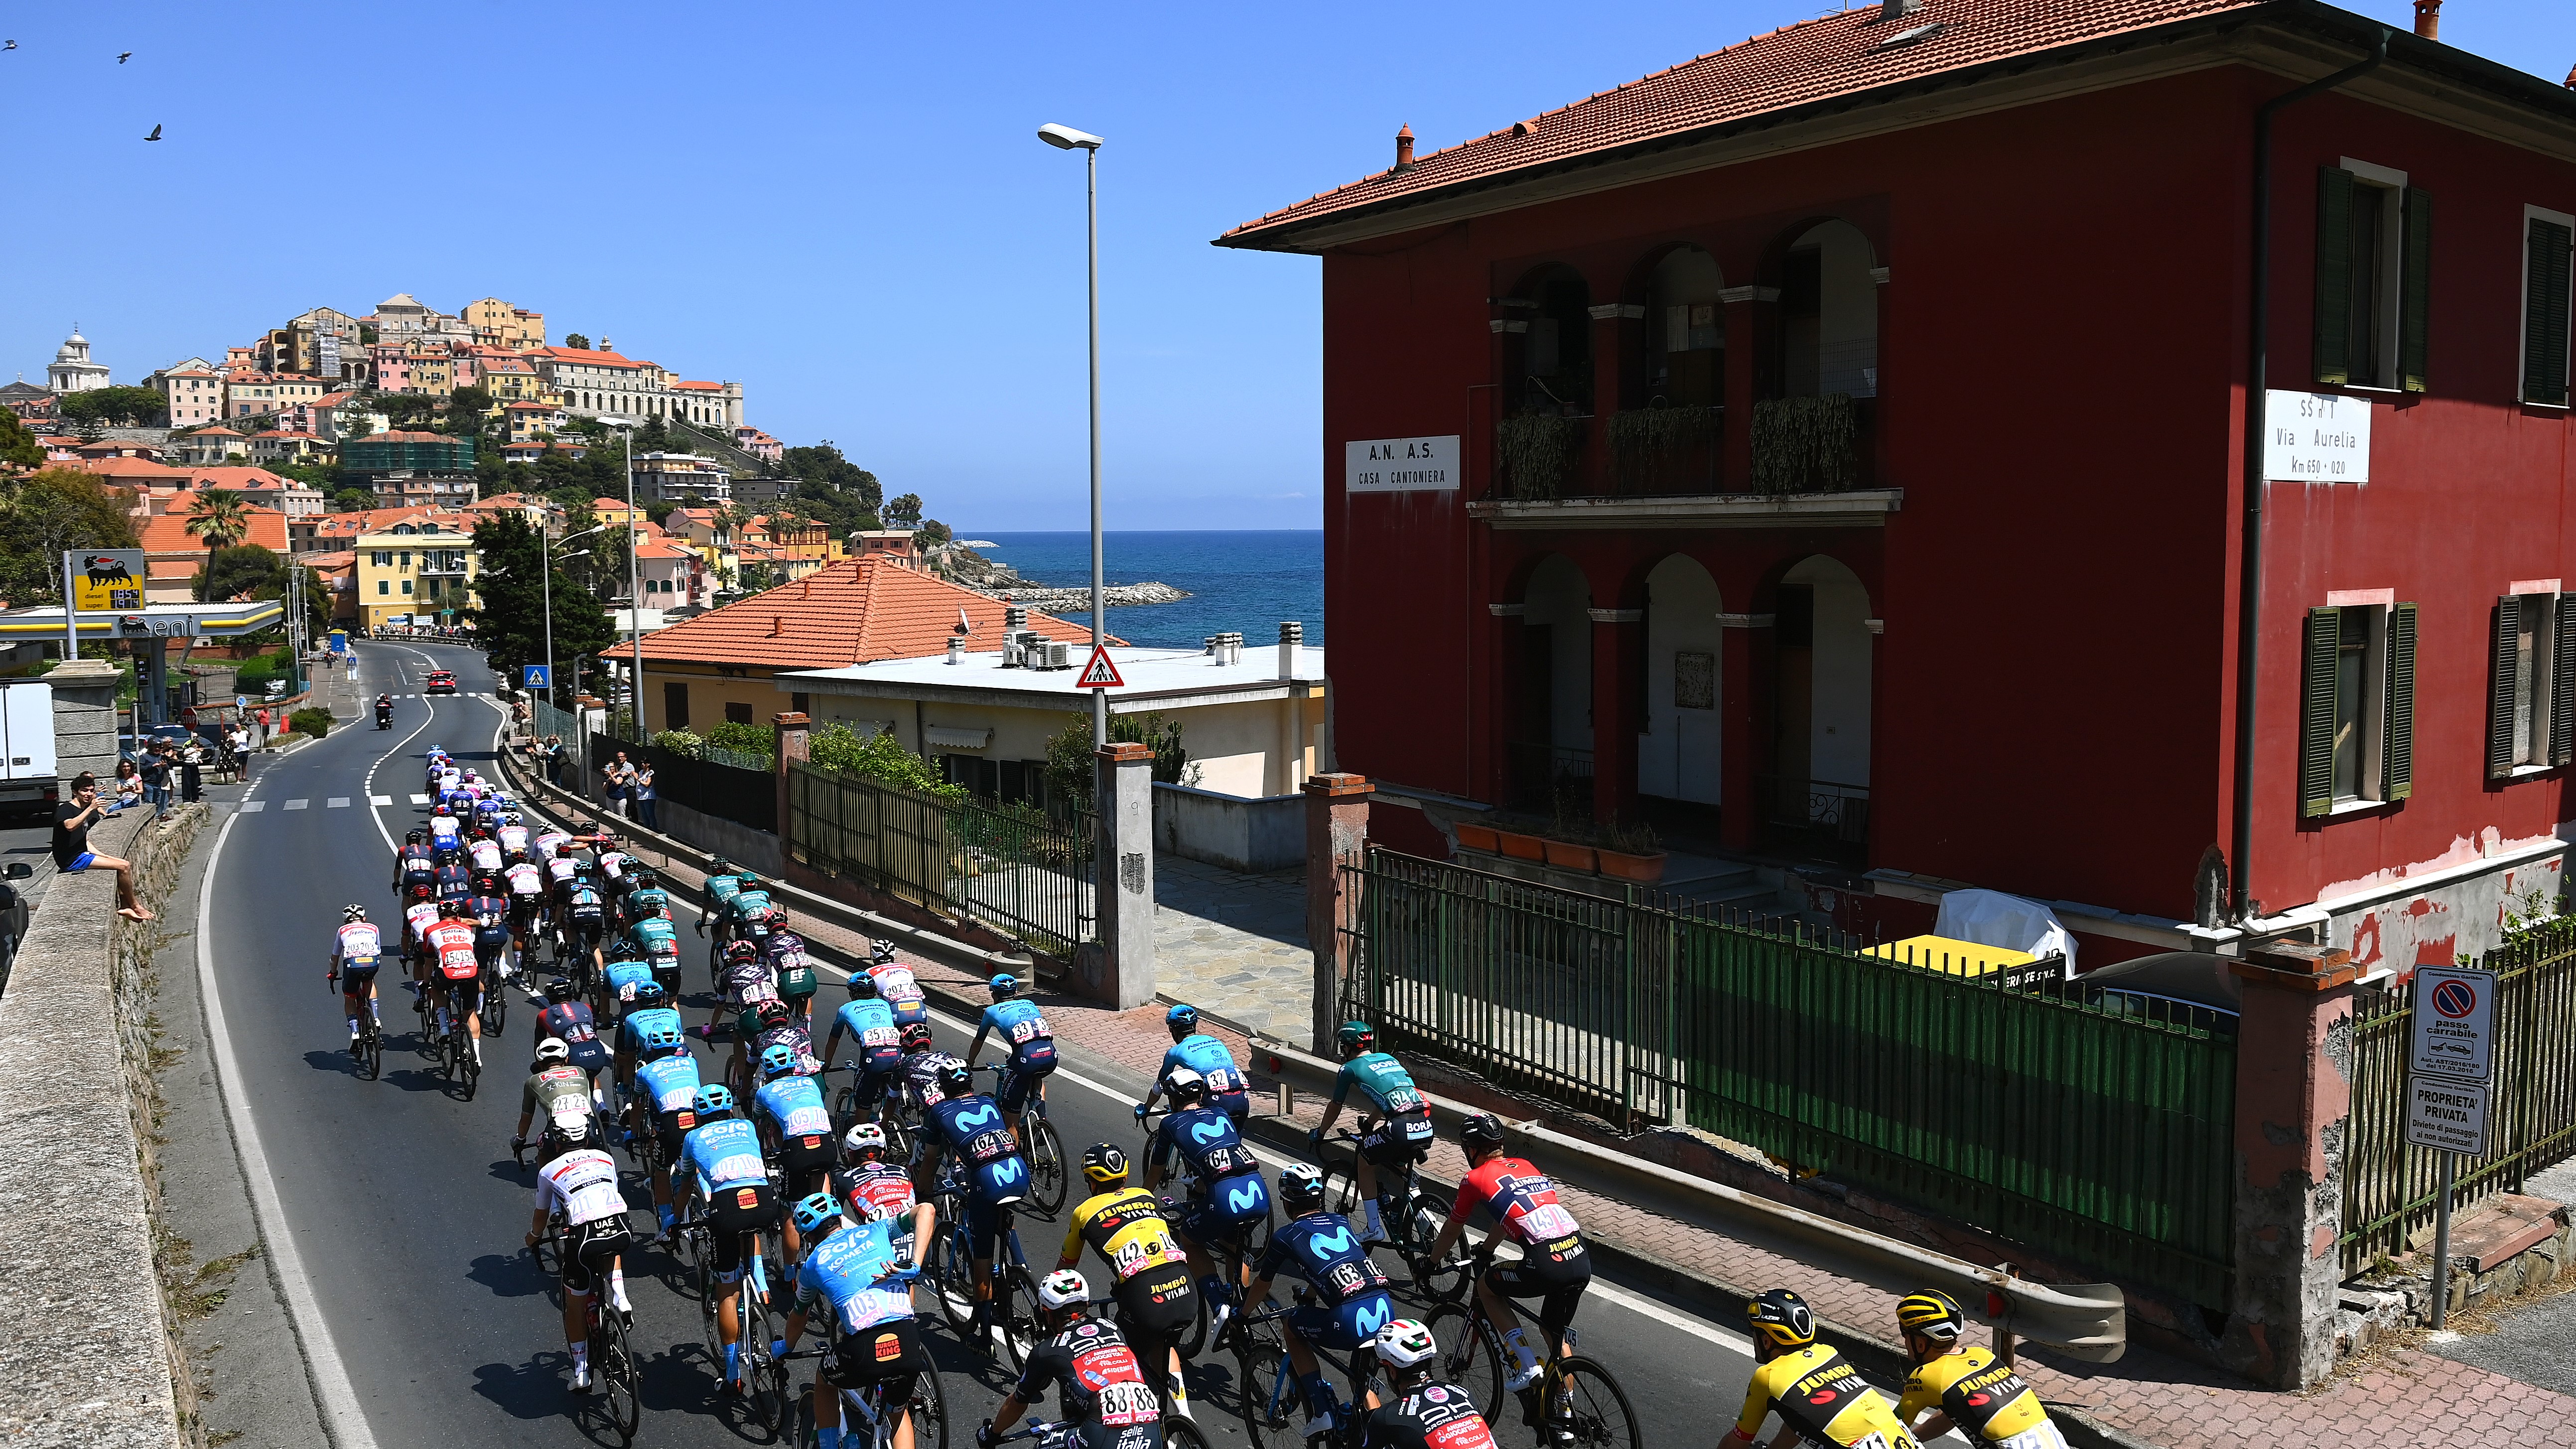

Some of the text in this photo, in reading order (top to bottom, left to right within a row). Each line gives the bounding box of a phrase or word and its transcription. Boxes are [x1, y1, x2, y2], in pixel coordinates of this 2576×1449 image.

[2277, 428, 2355, 448] Via Aurelia
[2307, 459, 2320, 474] 650
[2331, 460, 2345, 474] 020
[1358, 470, 1445, 485] CASA CANTONIERA
[153, 614, 193, 636] eni
[182, 714, 196, 723] STOP
[346, 943, 359, 953] 203
[650, 941, 660, 951] 66
[445, 952, 459, 964] 154
[782, 954, 793, 964] 95
[790, 968, 806, 981] EF
[622, 985, 632, 997] 31
[745, 988, 755, 998] 91
[765, 983, 776, 993] 91
[887, 984, 904, 996] 202
[1014, 1023, 1029, 1037] 33
[2436, 1020, 2469, 1029] passo
[867, 1028, 880, 1042] 35
[886, 1028, 899, 1040] 35
[1016, 1034, 1034, 1044] enel
[2426, 1028, 2478, 1039] carrabile
[1188, 1039, 1220, 1050] ASTANA
[652, 1059, 690, 1072] eolo
[2435, 1059, 2480, 1069] AST/2016/180
[2438, 1065, 2473, 1073] 17.03.2016
[657, 1066, 692, 1078] KOMETA
[772, 1079, 814, 1093] eolo
[1210, 1072, 1225, 1087] 32
[2421, 1081, 2452, 1089] Condominio
[924, 1082, 940, 1096] 93
[1359, 1084, 1388, 1111] hansgrohe
[2418, 1089, 2478, 1110] PROPRIETA'
[789, 1110, 809, 1127] 105
[2425, 1105, 2468, 1124] PRIVATA
[699, 1122, 748, 1139] eolo
[1406, 1119, 1432, 1132] BORA
[2412, 1119, 2435, 1130] Divieto
[2444, 1126, 2478, 1139] passaggio
[704, 1132, 749, 1145] KOMETA
[972, 1134, 995, 1153] 162
[1363, 1133, 1385, 1149] BORA
[2438, 1136, 2473, 1148] autorizzati
[565, 1153, 597, 1164] UAE
[977, 1146, 999, 1161] enel
[568, 1158, 599, 1168] Emirates
[582, 1179, 602, 1187] UOMO
[716, 1171, 739, 1183] enel
[867, 1181, 903, 1191] GIOCATTOLI
[1509, 1177, 1548, 1191] JUMBO
[1527, 1182, 1554, 1192] VISMA
[738, 1197, 758, 1206] KING
[878, 1193, 908, 1201] SIDERMEC
[572, 1194, 593, 1217] 211
[1096, 1201, 1156, 1223] JUMBO
[1428, 1200, 1446, 1213] rov
[1121, 1209, 1159, 1219] VISMA
[594, 1217, 615, 1229] UAE
[1526, 1208, 1554, 1234] 145
[1501, 1222, 1516, 1238] HEMA
[1537, 1228, 1560, 1239] enel
[817, 1229, 870, 1264] eolo
[1146, 1243, 1159, 1254] 17
[1549, 1236, 1579, 1252] JUMBO
[827, 1239, 875, 1272] KOMETA
[1115, 1242, 1142, 1271] 142
[1562, 1244, 1585, 1261] VISMA
[1123, 1257, 1149, 1278] enel
[1243, 1254, 1253, 1269] 164
[1331, 1264, 1362, 1290] 163
[1150, 1275, 1187, 1294] JUMBO
[1343, 1279, 1366, 1296] enel
[1165, 1284, 1191, 1301] VISMA
[846, 1293, 877, 1323] 103
[856, 1309, 884, 1330] enel
[1334, 1321, 1340, 1330] P.
[875, 1338, 900, 1348] BURGER
[1564, 1330, 1577, 1347] 145
[875, 1345, 901, 1357] KING
[1074, 1346, 1100, 1358] DRONE
[1091, 1351, 1124, 1362] GIOCATTOLI
[1093, 1347, 1118, 1356] ANDRONI
[1106, 1364, 1133, 1374] SIDERMEC
[1366, 1376, 1380, 1395] 163
[1796, 1363, 1856, 1397] JUMBO
[1104, 1387, 1127, 1414] 88
[1134, 1387, 1155, 1411] 88
[1425, 1416, 1454, 1433] DRONE
[1446, 1416, 1473, 1432] ANDRONI
[1120, 1425, 1144, 1439] selle
[1445, 1423, 1480, 1440] GIOCATTOLI
[1467, 1432, 1485, 1443] COLLI
[1116, 1436, 1151, 1449] italia
